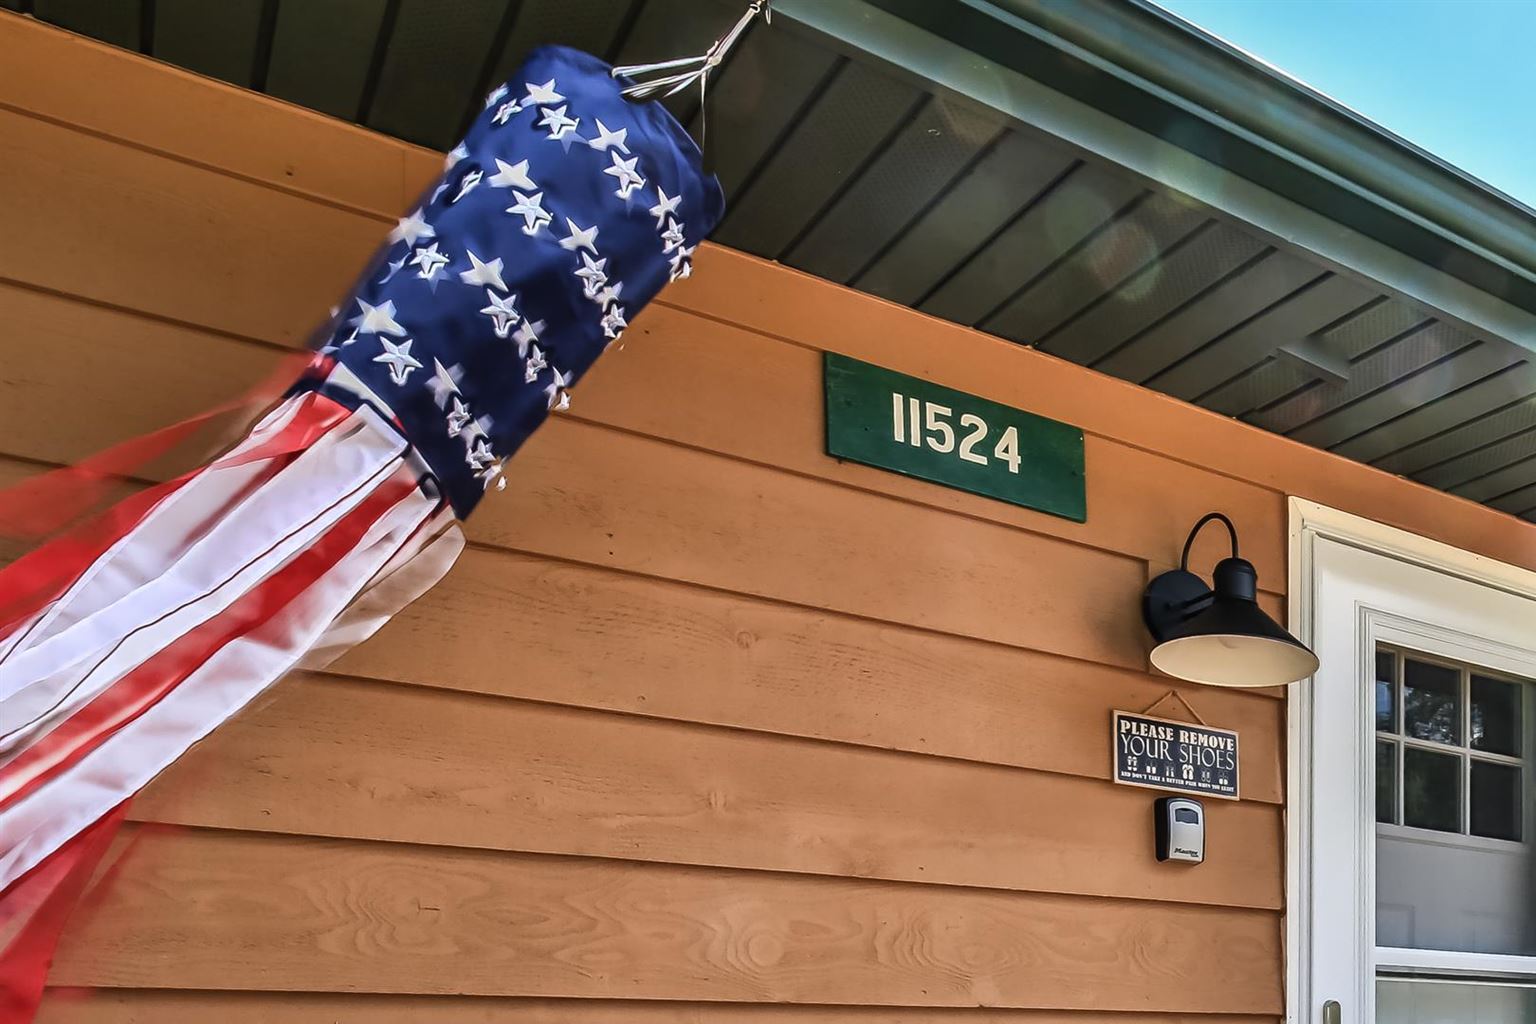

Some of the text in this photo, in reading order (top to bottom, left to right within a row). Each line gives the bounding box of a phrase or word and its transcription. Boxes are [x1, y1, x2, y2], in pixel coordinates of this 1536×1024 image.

[893, 392, 1022, 474] 11524
[1120, 719, 1234, 751] PLEASE REMOVE
[1121, 733, 1235, 770] YOUR SHOES
